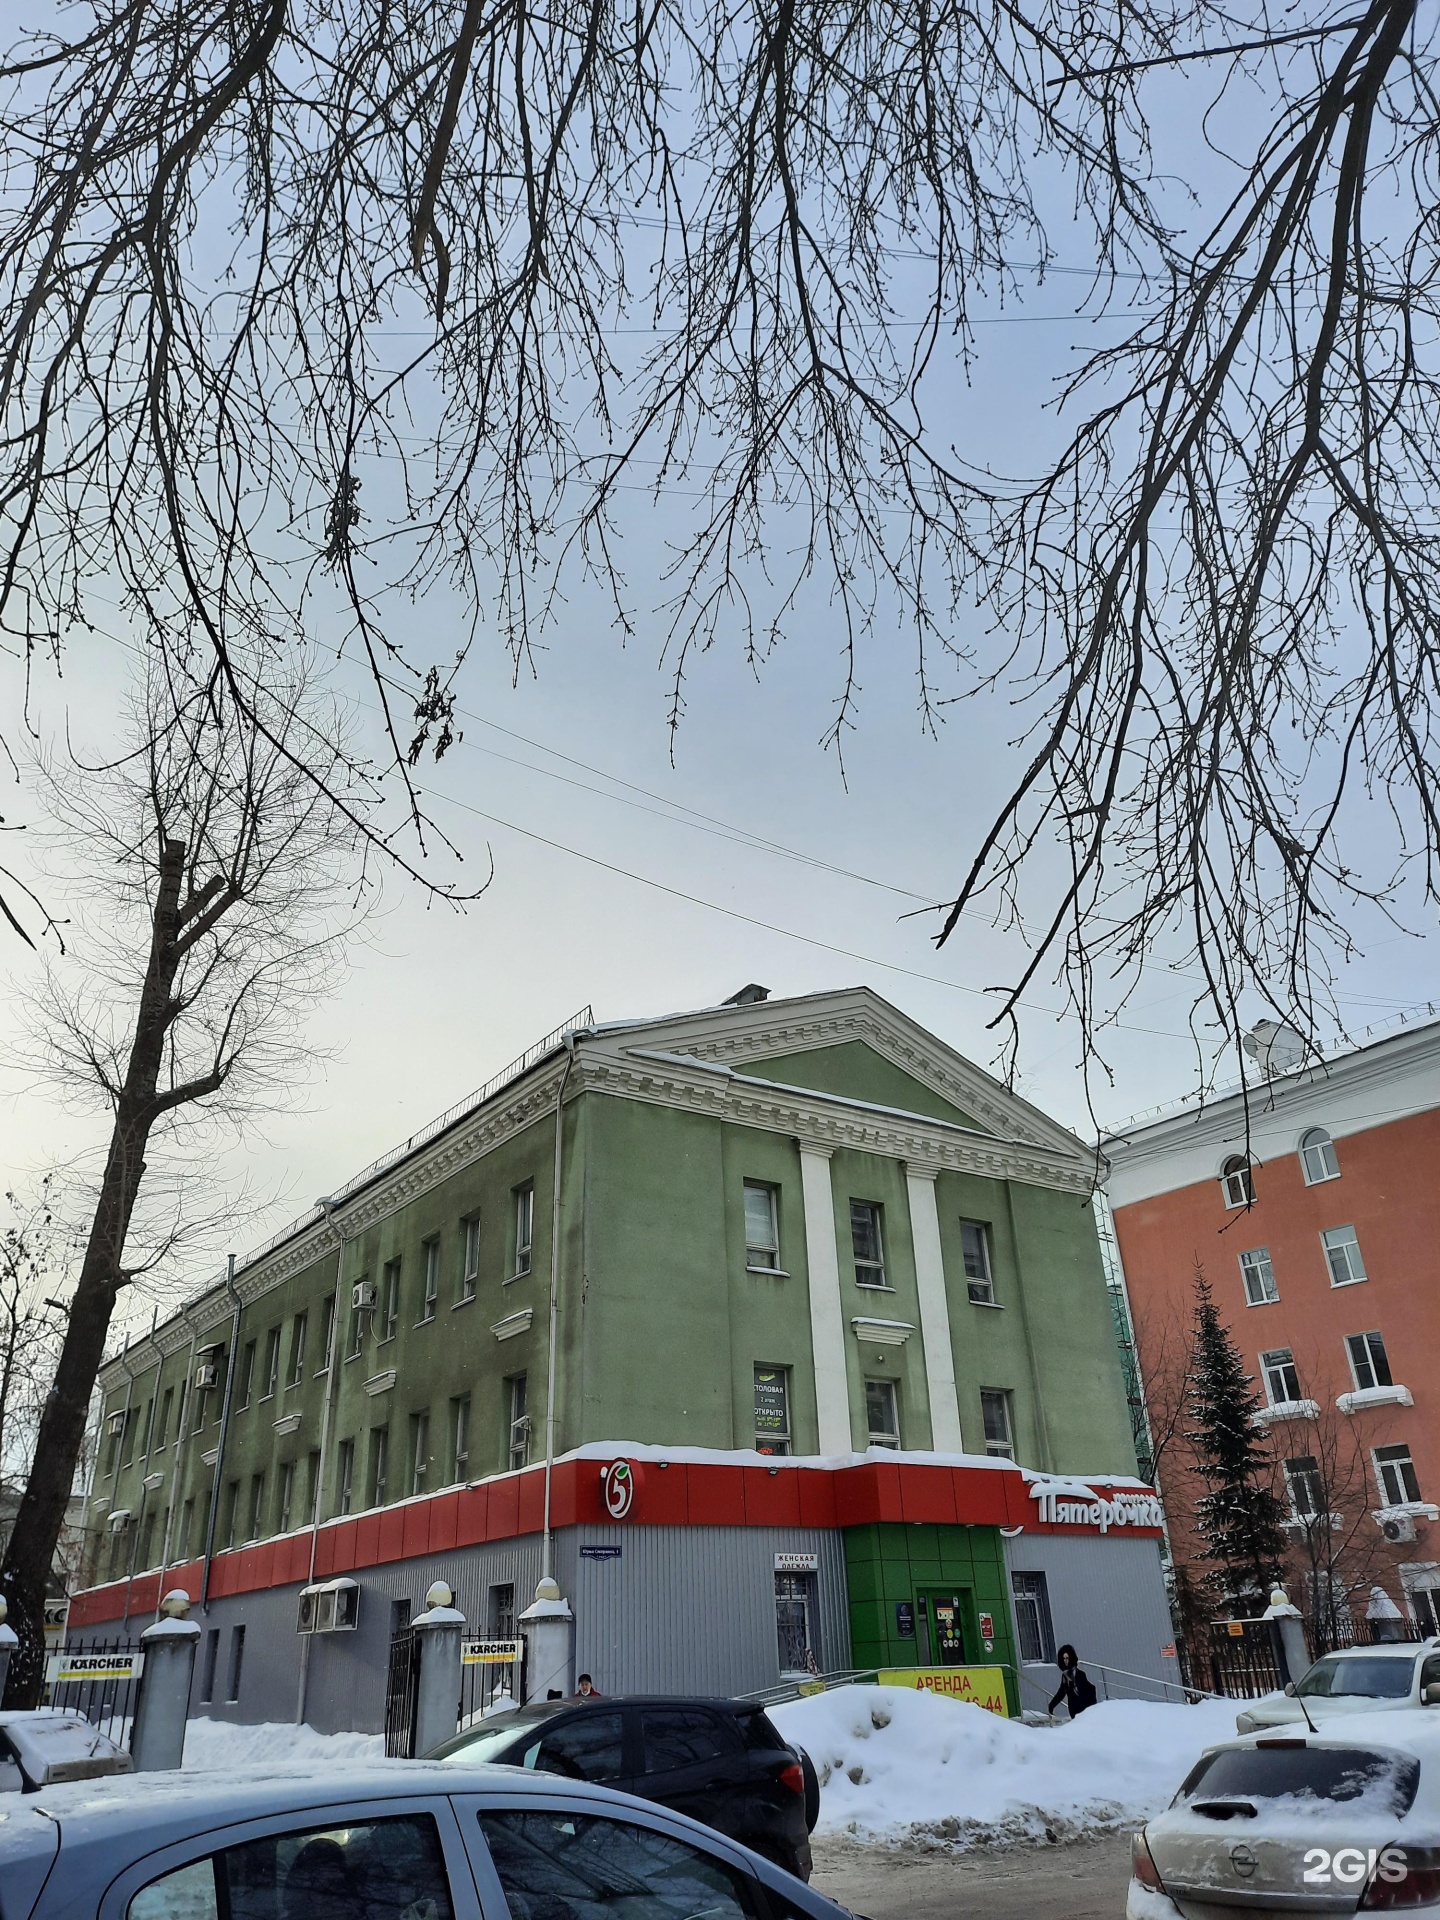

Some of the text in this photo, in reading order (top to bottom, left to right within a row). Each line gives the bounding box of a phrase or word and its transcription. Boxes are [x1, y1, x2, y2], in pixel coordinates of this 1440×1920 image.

[754, 1407, 784, 1417] ОТКРЫТО
[470, 1643, 516, 1654] KÄRCHER
[70, 1657, 133, 1670] KÄRCHER
[916, 1675, 972, 1694] АРЕНДА
